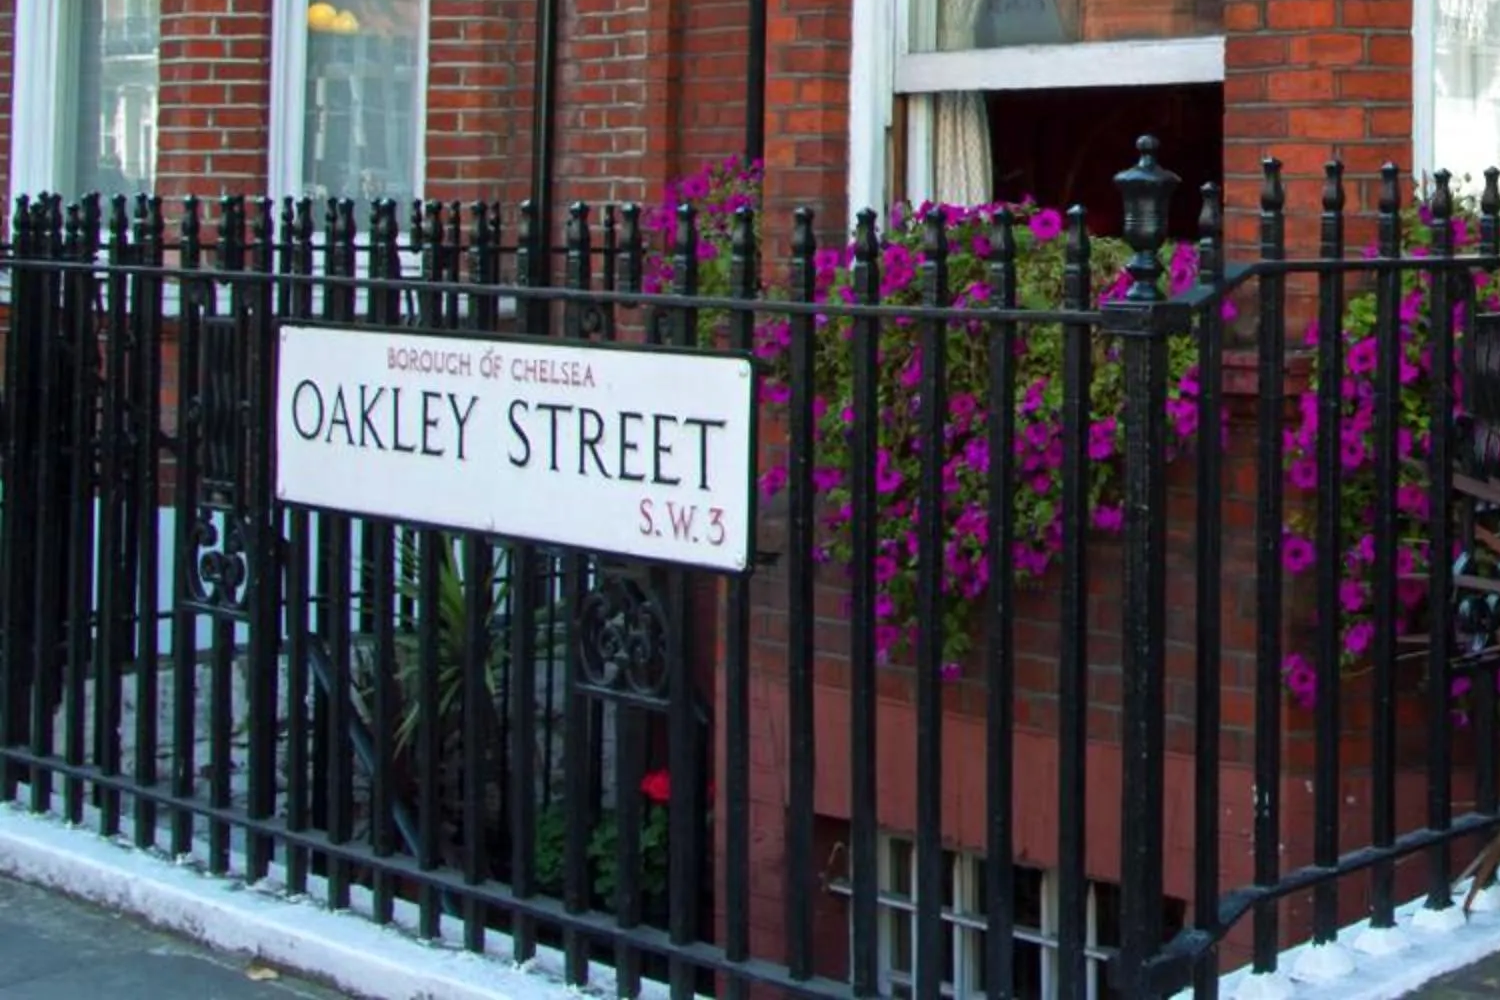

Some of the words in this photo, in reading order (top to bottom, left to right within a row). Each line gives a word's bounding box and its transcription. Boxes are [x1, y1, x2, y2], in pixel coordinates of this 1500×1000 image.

[387, 347, 471, 376] BOROUGH
[510, 358, 595, 387] CHELSEA
[292, 379, 479, 460] OAKLEY
[507, 399, 727, 490] STREET
